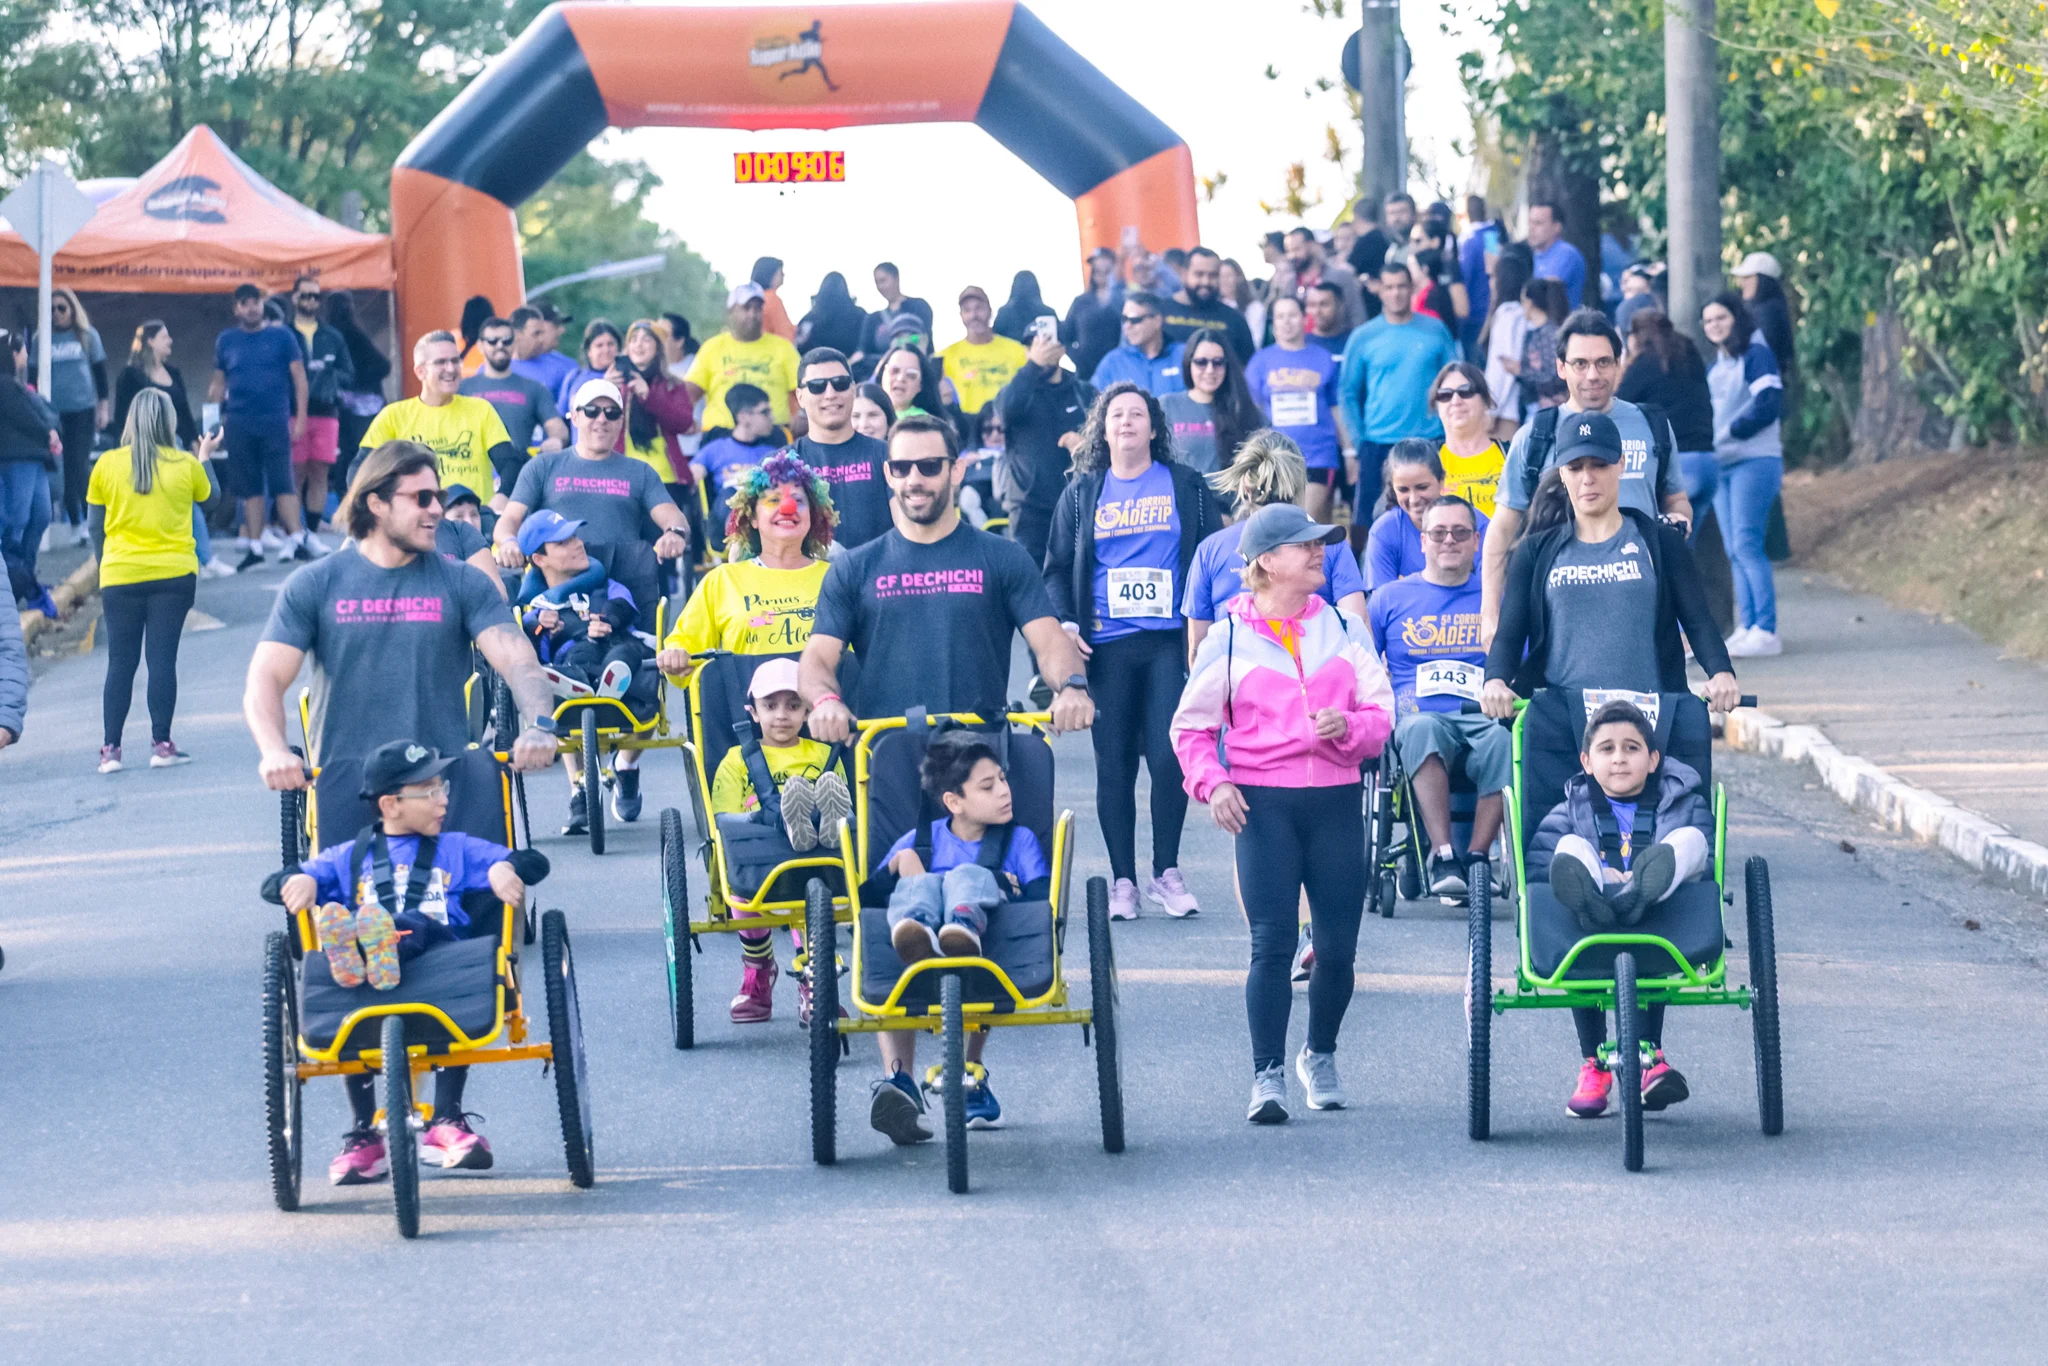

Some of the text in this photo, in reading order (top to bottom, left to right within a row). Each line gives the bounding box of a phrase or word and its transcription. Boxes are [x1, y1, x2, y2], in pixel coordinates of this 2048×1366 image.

[735, 152, 845, 182] 00:09:06
[573, 477, 630, 490] DECHICHI
[1136, 495, 1172, 509] CORRIDA
[1119, 506, 1173, 528] ADEFIP
[876, 569, 983, 590] CF DECHICHI
[1119, 583, 1156, 601] 403
[336, 597, 442, 615] CF DECHICHI
[744, 594, 800, 612] Pernas
[1453, 613, 1482, 626] CORRI
[1435, 625, 1481, 647] ADEFI
[1429, 670, 1467, 685] 443
